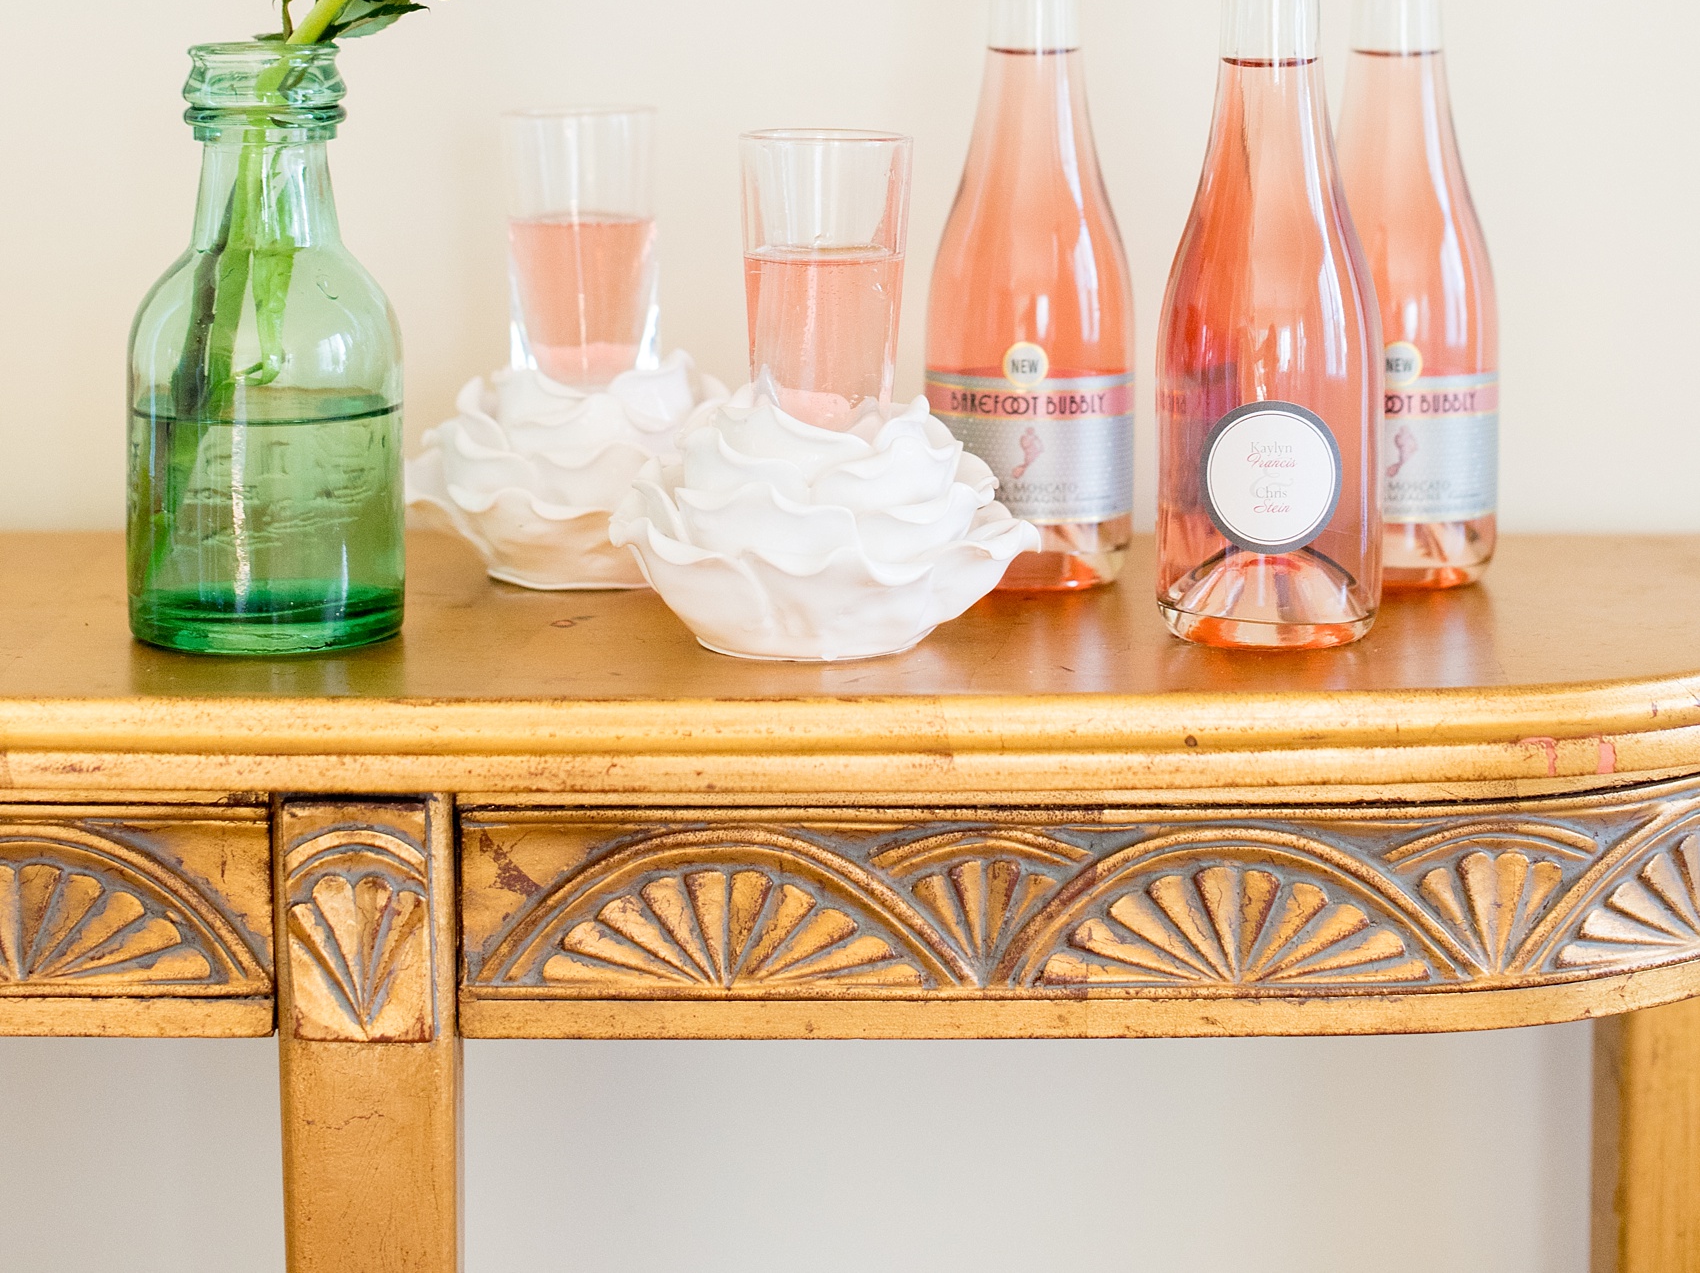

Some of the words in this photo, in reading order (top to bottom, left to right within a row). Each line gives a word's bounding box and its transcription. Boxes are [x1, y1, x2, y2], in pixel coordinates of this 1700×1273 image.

[1011, 359, 1039, 374] NEW
[1386, 358, 1414, 372] NEW
[950, 391, 1038, 415] BAREFOOT
[1046, 394, 1106, 414] BUBBLY
[1420, 392, 1477, 413] BUBBLY
[1250, 441, 1293, 456] Kaylyn
[1247, 452, 1296, 469] Francis
[1255, 486, 1287, 499] Chris
[1253, 499, 1291, 514] Stein
